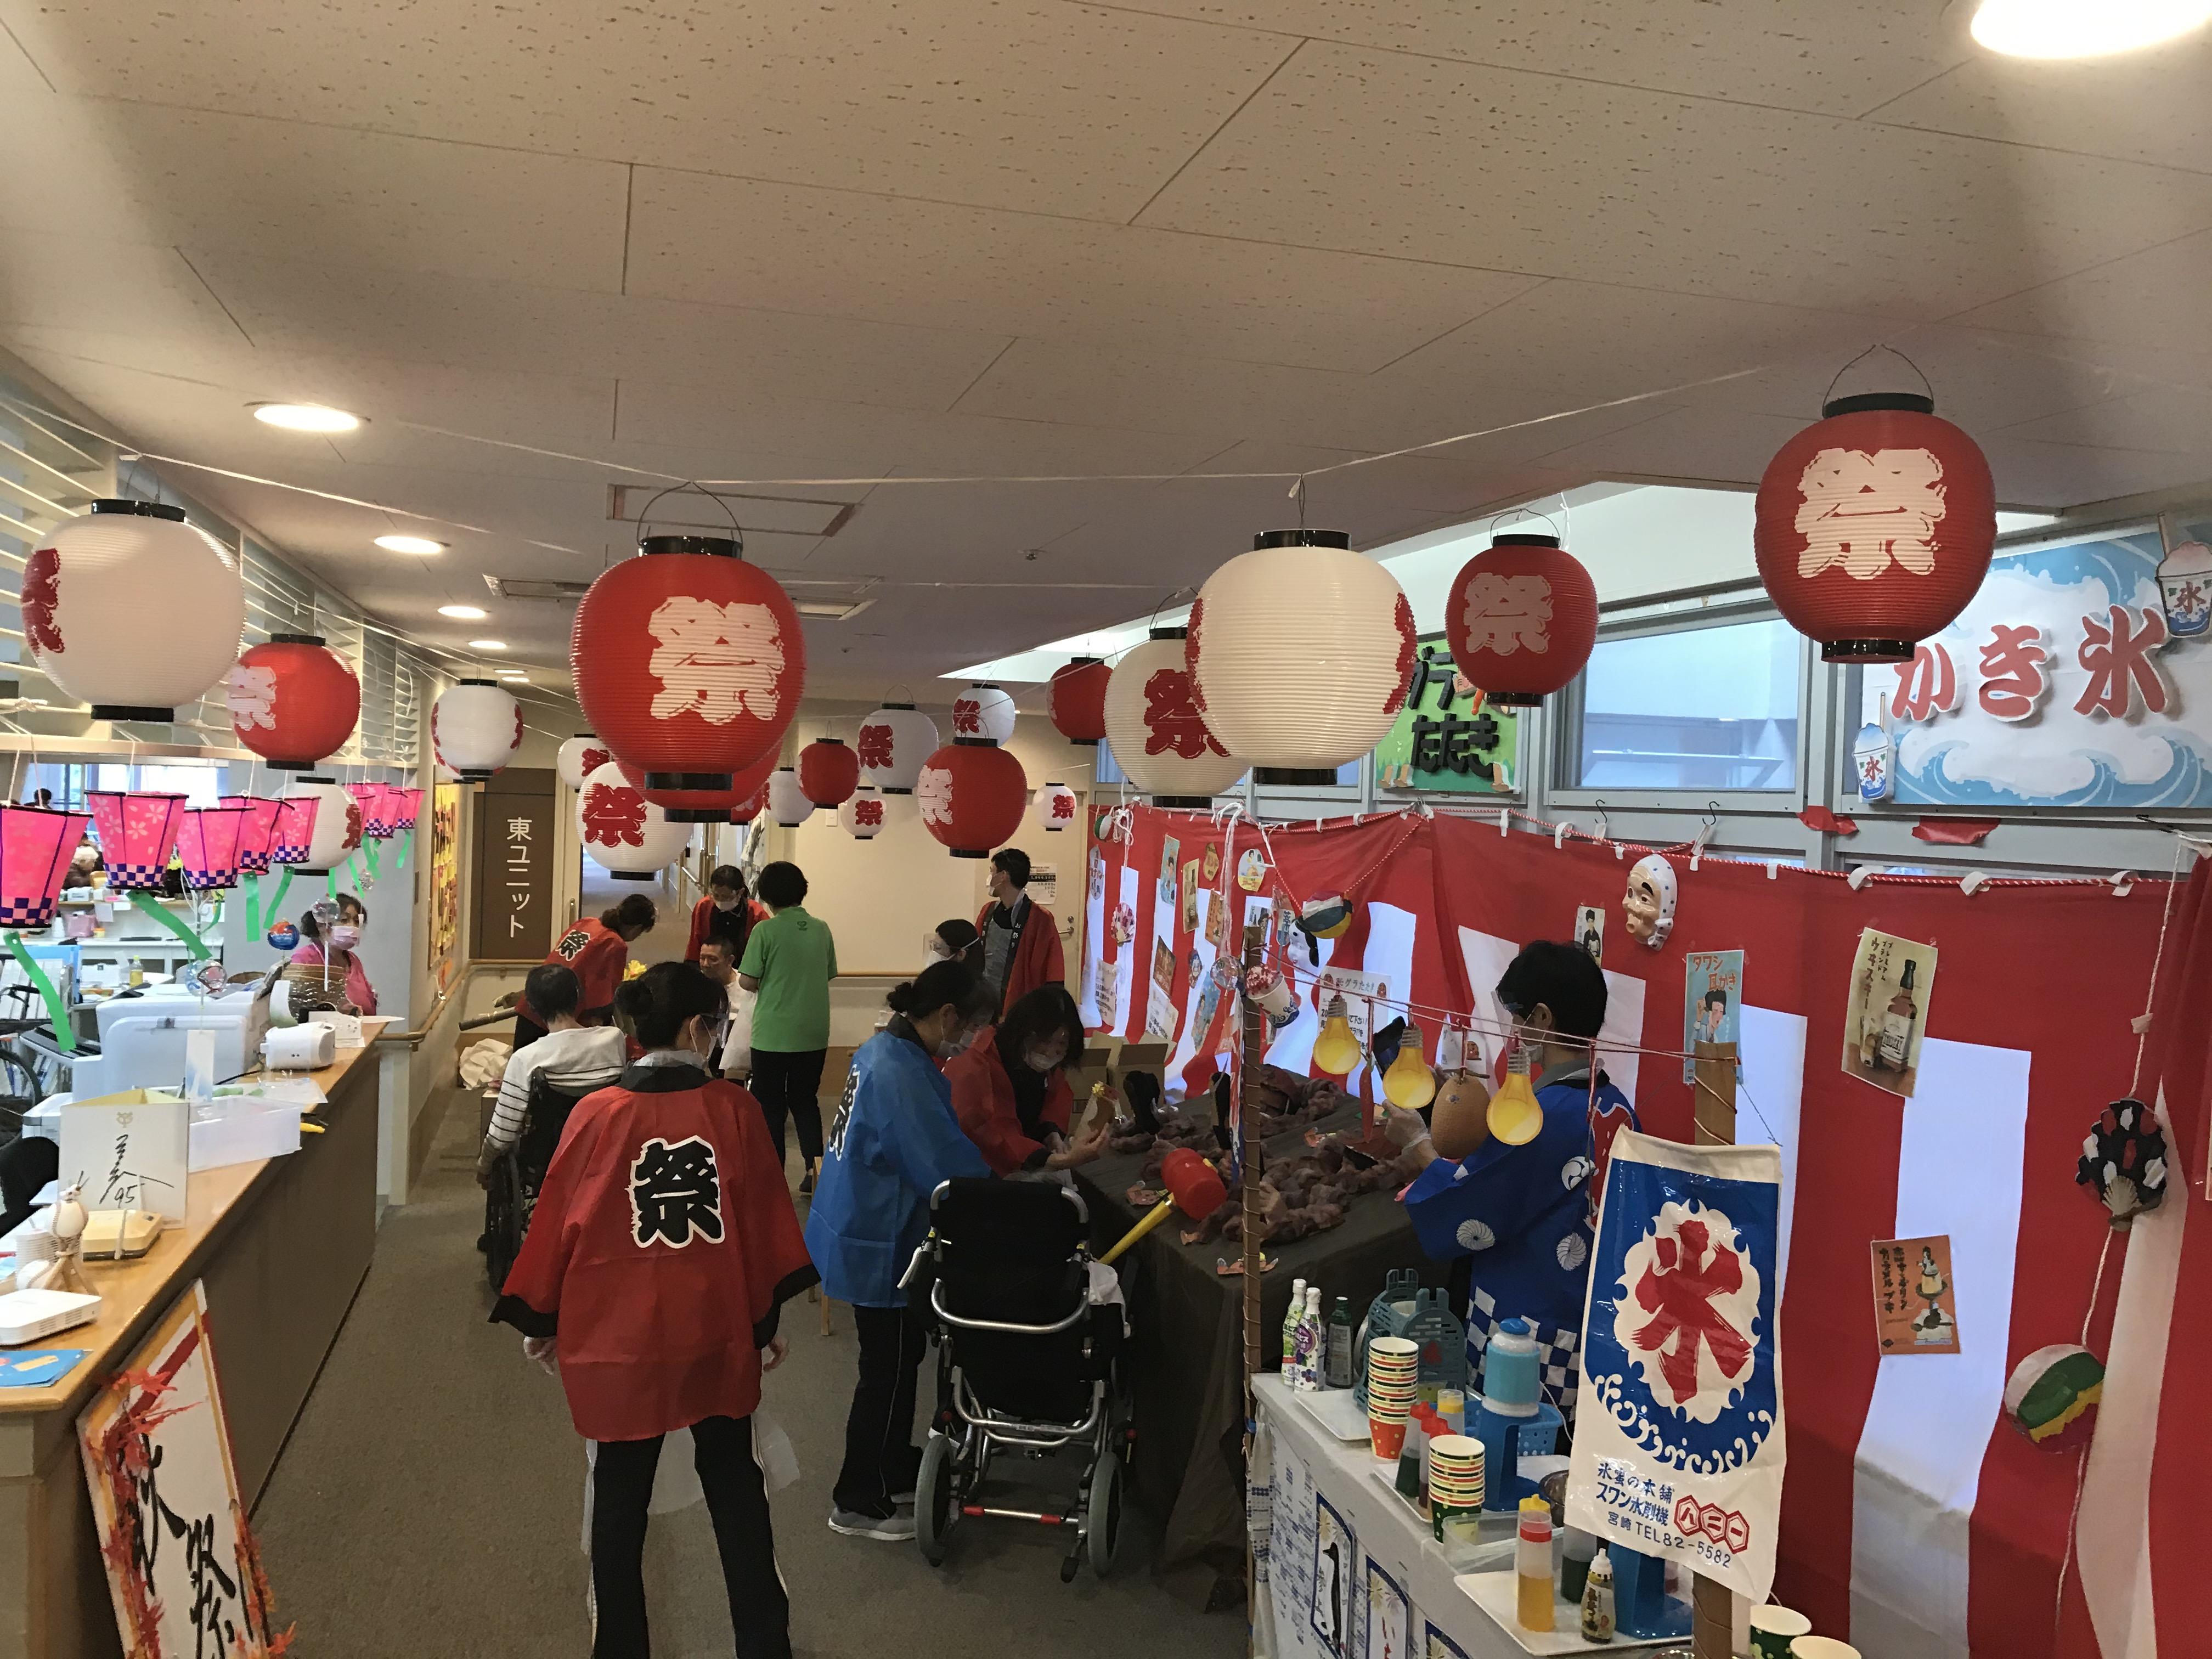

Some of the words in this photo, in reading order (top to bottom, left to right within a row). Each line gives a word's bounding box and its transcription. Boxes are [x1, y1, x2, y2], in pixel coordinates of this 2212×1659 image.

[1795, 447, 1947, 580] 祭
[1464, 572, 1554, 656] 祭
[2174, 580, 2208, 614] 氷
[648, 596, 785, 725] 祭
[1891, 603, 2169, 723] かき氷
[952, 698, 981, 733] 祭
[857, 724, 894, 769] 祭
[1410, 713, 1500, 778] たたき
[1865, 755, 1883, 783] 氷
[582, 783, 647, 848] 祭
[855, 799, 883, 826] 祭
[1052, 794, 1075, 819] 祭
[506, 816, 533, 938] 東ユニット
[555, 929, 592, 962] 祭
[1692, 955, 1724, 972] タワシ
[1708, 972, 1737, 991] 耳かき
[624, 1135, 725, 1249] 祭
[1630, 1219, 1753, 1404] 氷
